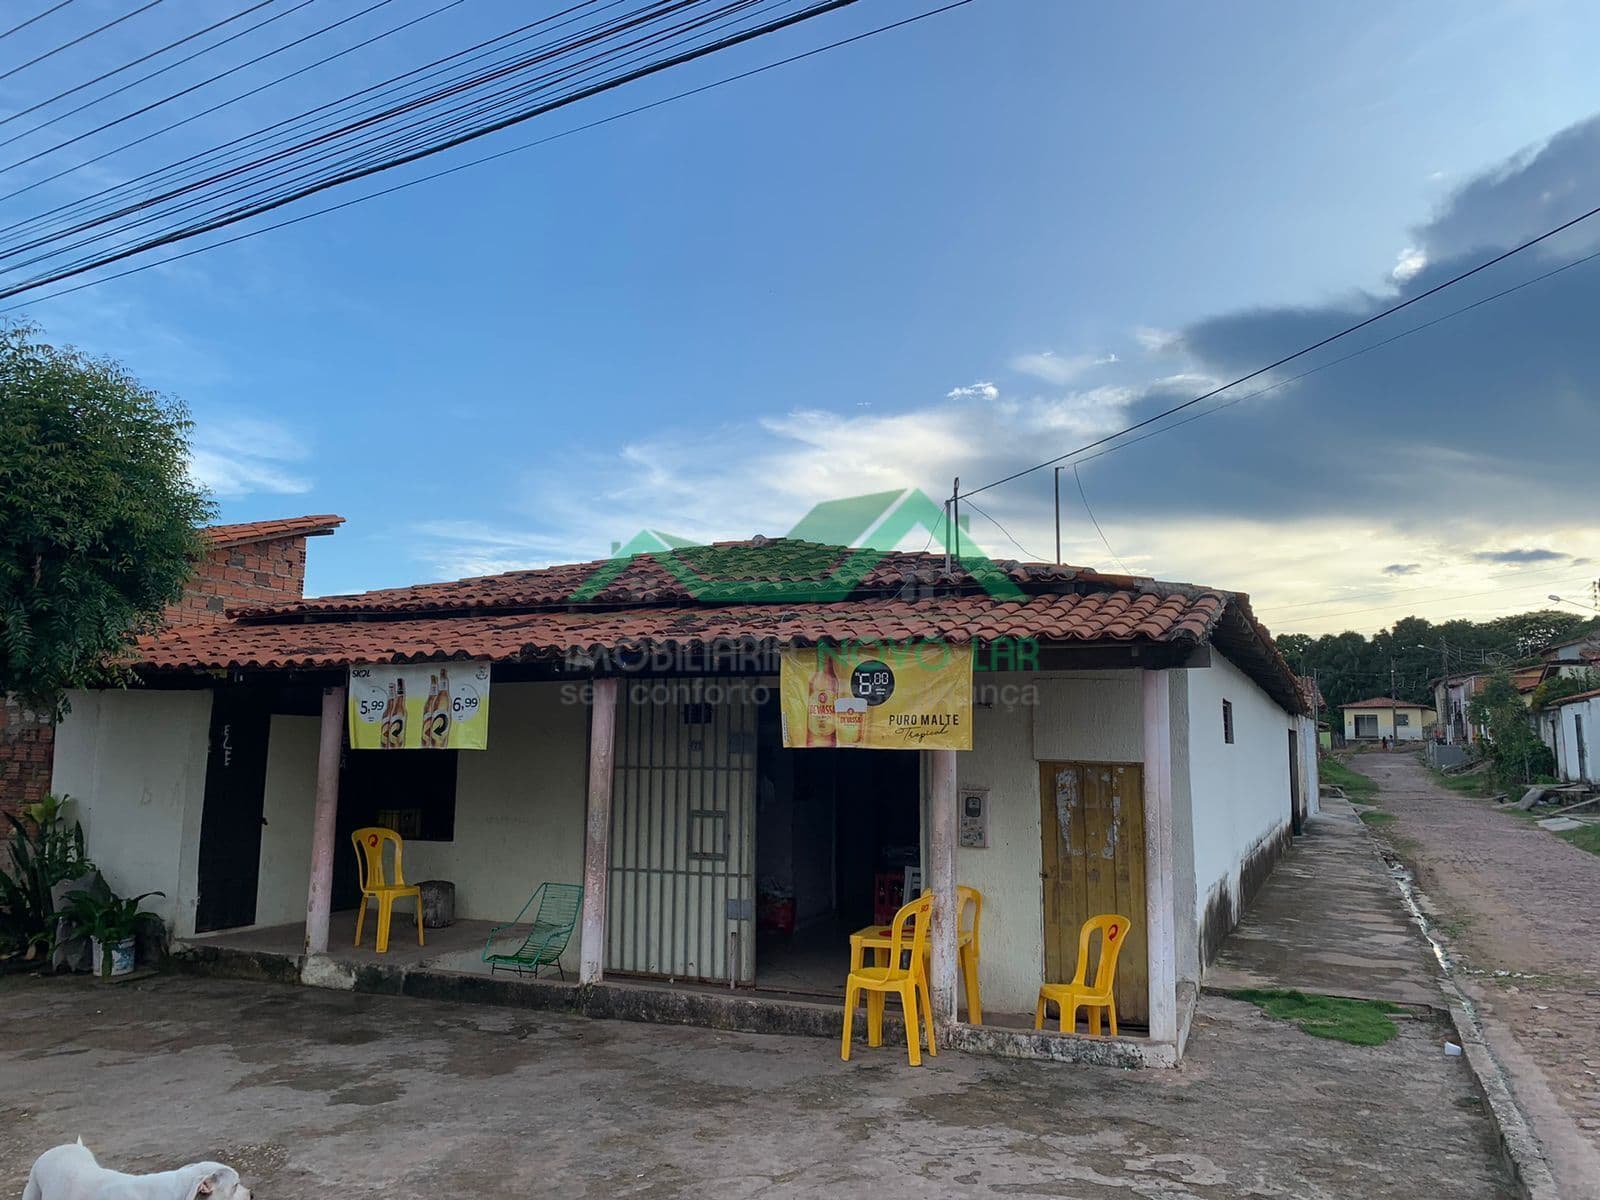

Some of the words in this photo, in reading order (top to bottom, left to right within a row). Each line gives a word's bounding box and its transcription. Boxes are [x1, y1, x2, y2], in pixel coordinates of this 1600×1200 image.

[352, 669, 372, 678] SKOL
[360, 700, 385, 715] 5,99
[452, 697, 478, 712] 6,99
[889, 714, 917, 726] PURO
[920, 713, 960, 726] MALTE
[894, 723, 949, 743] Tropical
